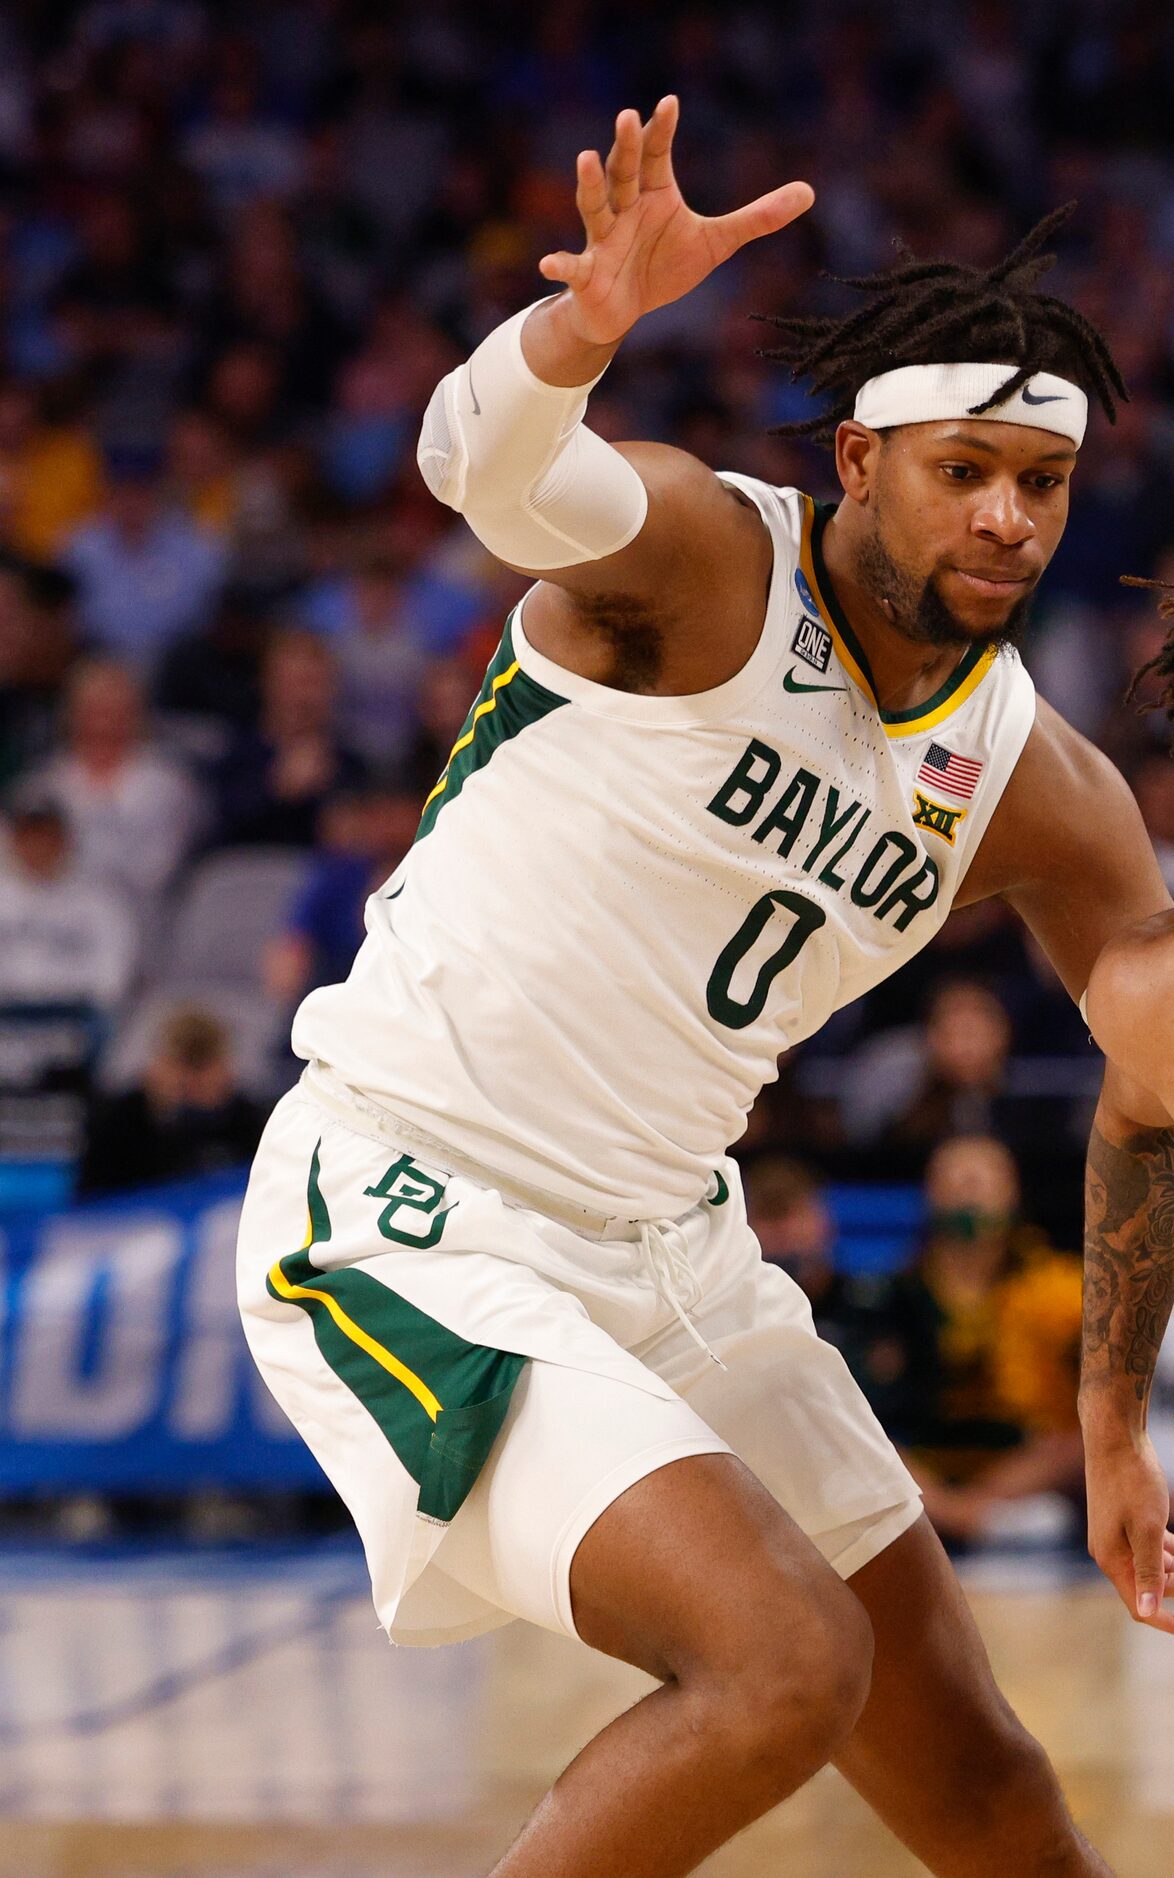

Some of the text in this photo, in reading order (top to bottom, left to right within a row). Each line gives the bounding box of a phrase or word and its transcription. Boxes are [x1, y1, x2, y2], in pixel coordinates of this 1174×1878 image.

[797, 620, 831, 664] ONE
[706, 738, 939, 933] BAYLOR
[912, 794, 962, 841] XII
[706, 889, 826, 1029] 0
